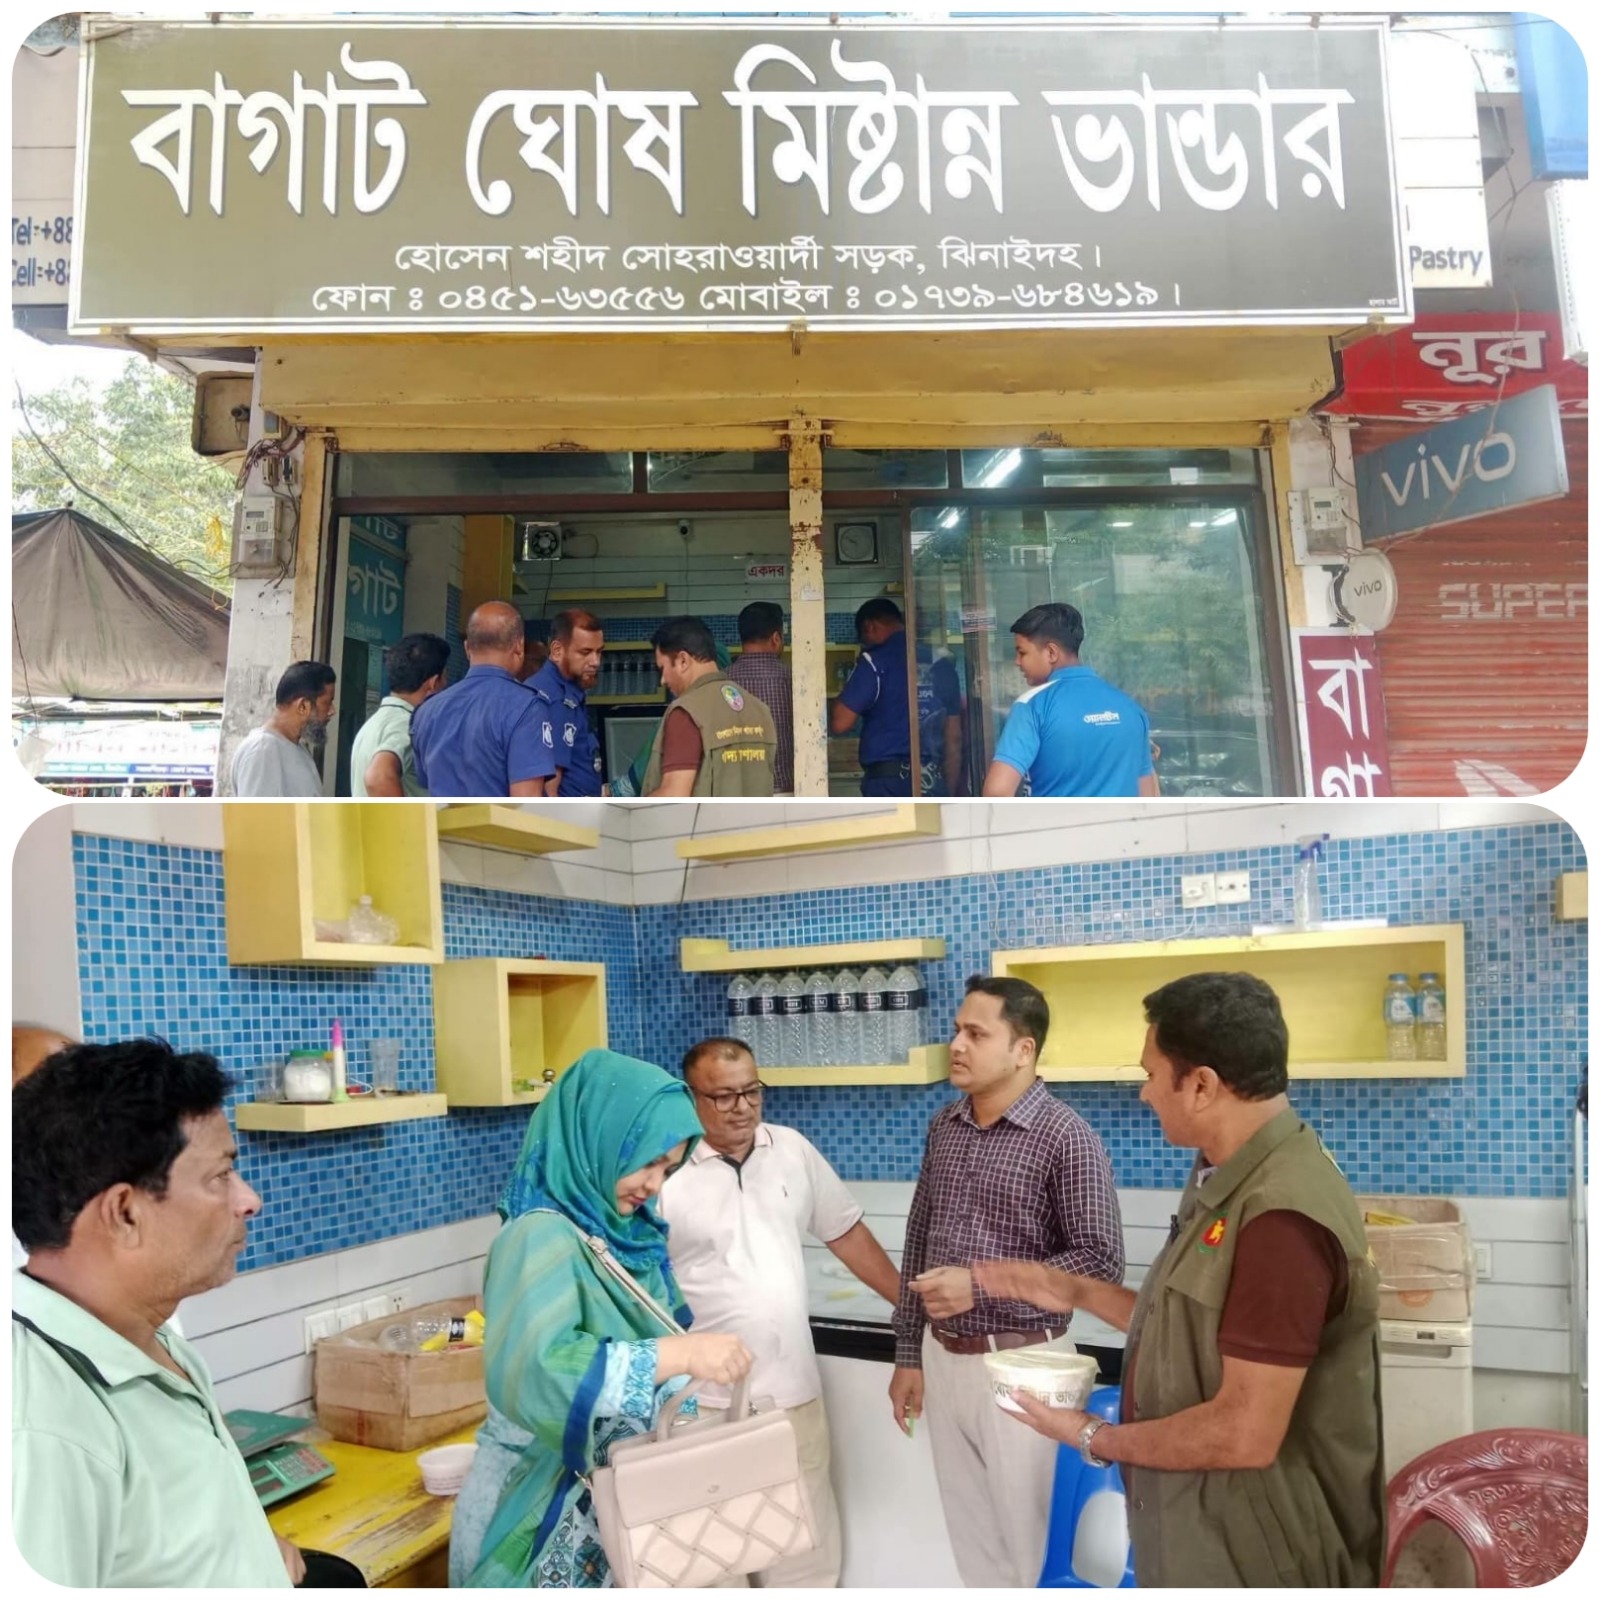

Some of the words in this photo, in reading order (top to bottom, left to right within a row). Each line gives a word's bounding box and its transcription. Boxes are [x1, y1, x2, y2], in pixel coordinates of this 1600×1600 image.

[121, 42, 427, 215] বাগাট
[465, 72, 699, 216] ঘোষ
[722, 38, 1019, 216] মিষ্টান্ন
[1041, 71, 1356, 213] ভান্ডার
[395, 242, 512, 273] হোসেন
[520, 235, 610, 273] শহীদ
[622, 235, 824, 273] সোহরাওয়ার্দী
[831, 243, 927, 275] সড়ক,
[936, 236, 1083, 271] ঝিনাইদহ
[1409, 245, 1483, 276] Pastry
[12, 257, 71, 286] ell:+8
[312, 283, 397, 312] ফোন
[438, 286, 685, 311] ০৪৫১-৬৩৫৫৬
[699, 281, 834, 312] মোবাইল
[874, 282, 1160, 308] ০১৭৩৯-৬৮৪৬১৯
[1412, 330, 1547, 385] নূর
[1381, 431, 1517, 507] vivo
[747, 565, 785, 579] একদর
[1354, 579, 1384, 599] vivo
